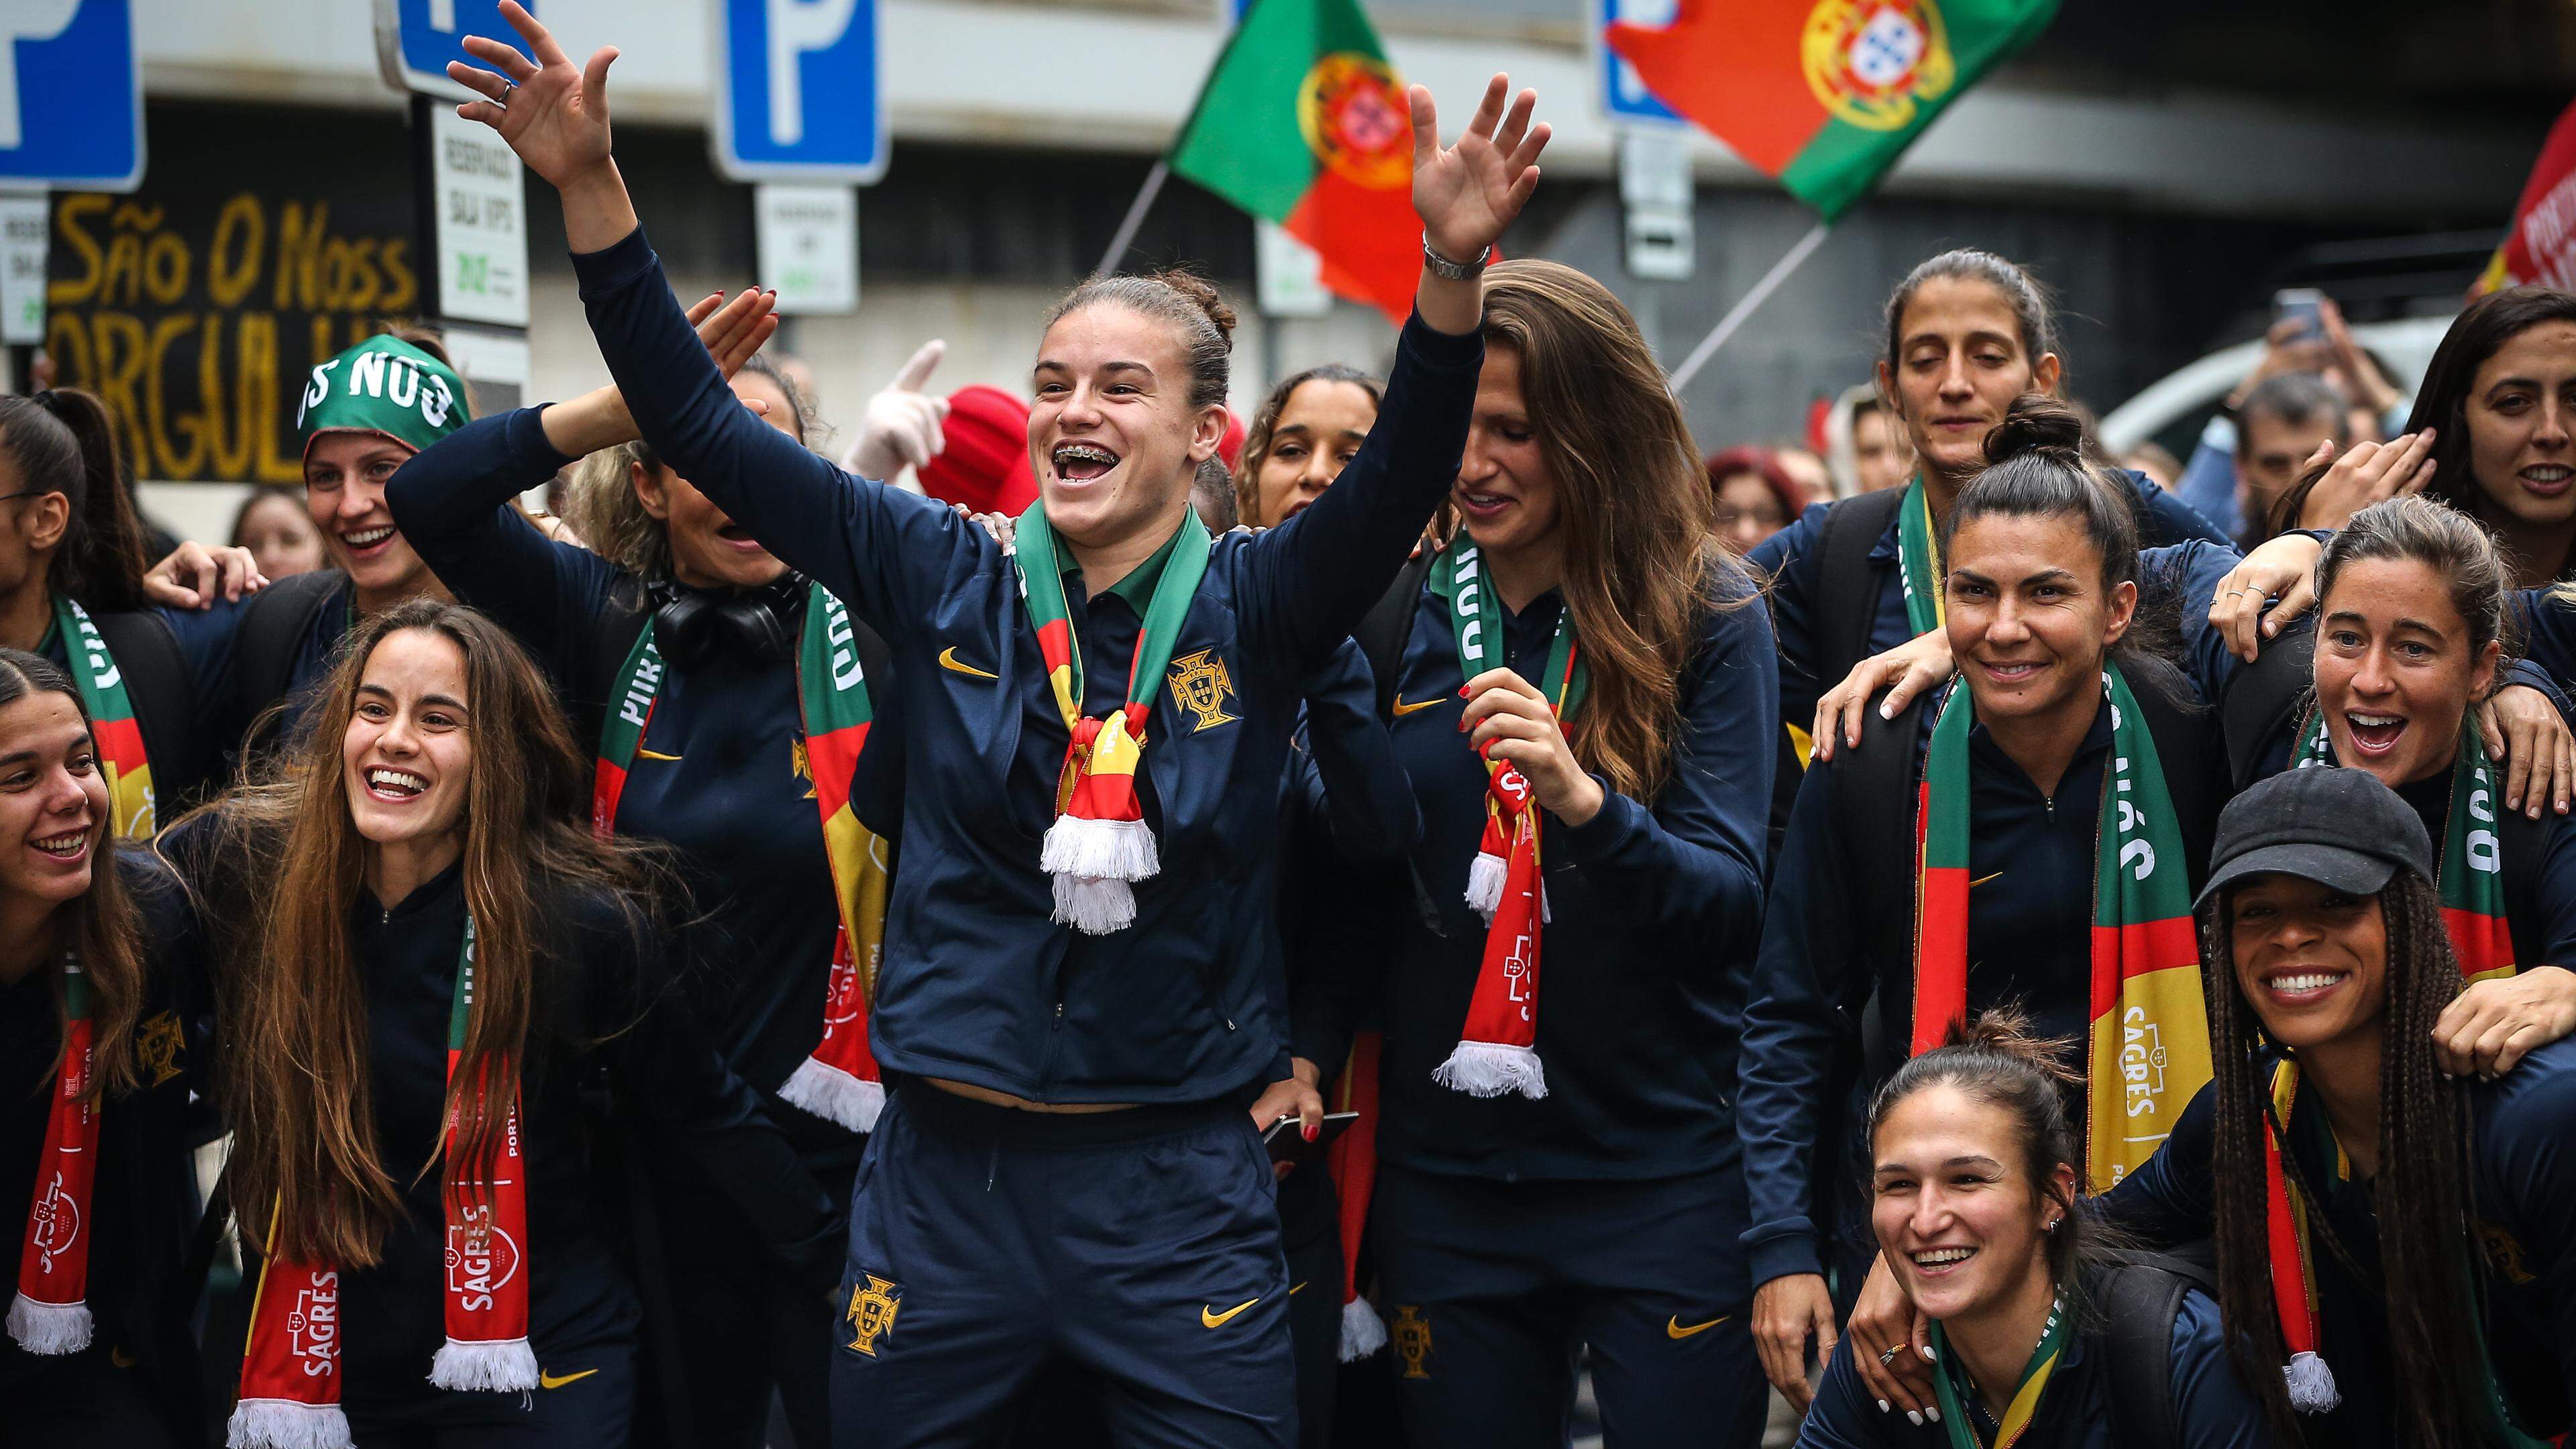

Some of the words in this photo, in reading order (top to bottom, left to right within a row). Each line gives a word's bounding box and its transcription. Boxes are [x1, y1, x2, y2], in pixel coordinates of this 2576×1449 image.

[209, 193, 264, 307] O
[2123, 1006, 2155, 1118] SAGRES
[304, 1271, 339, 1377] SAGRES
